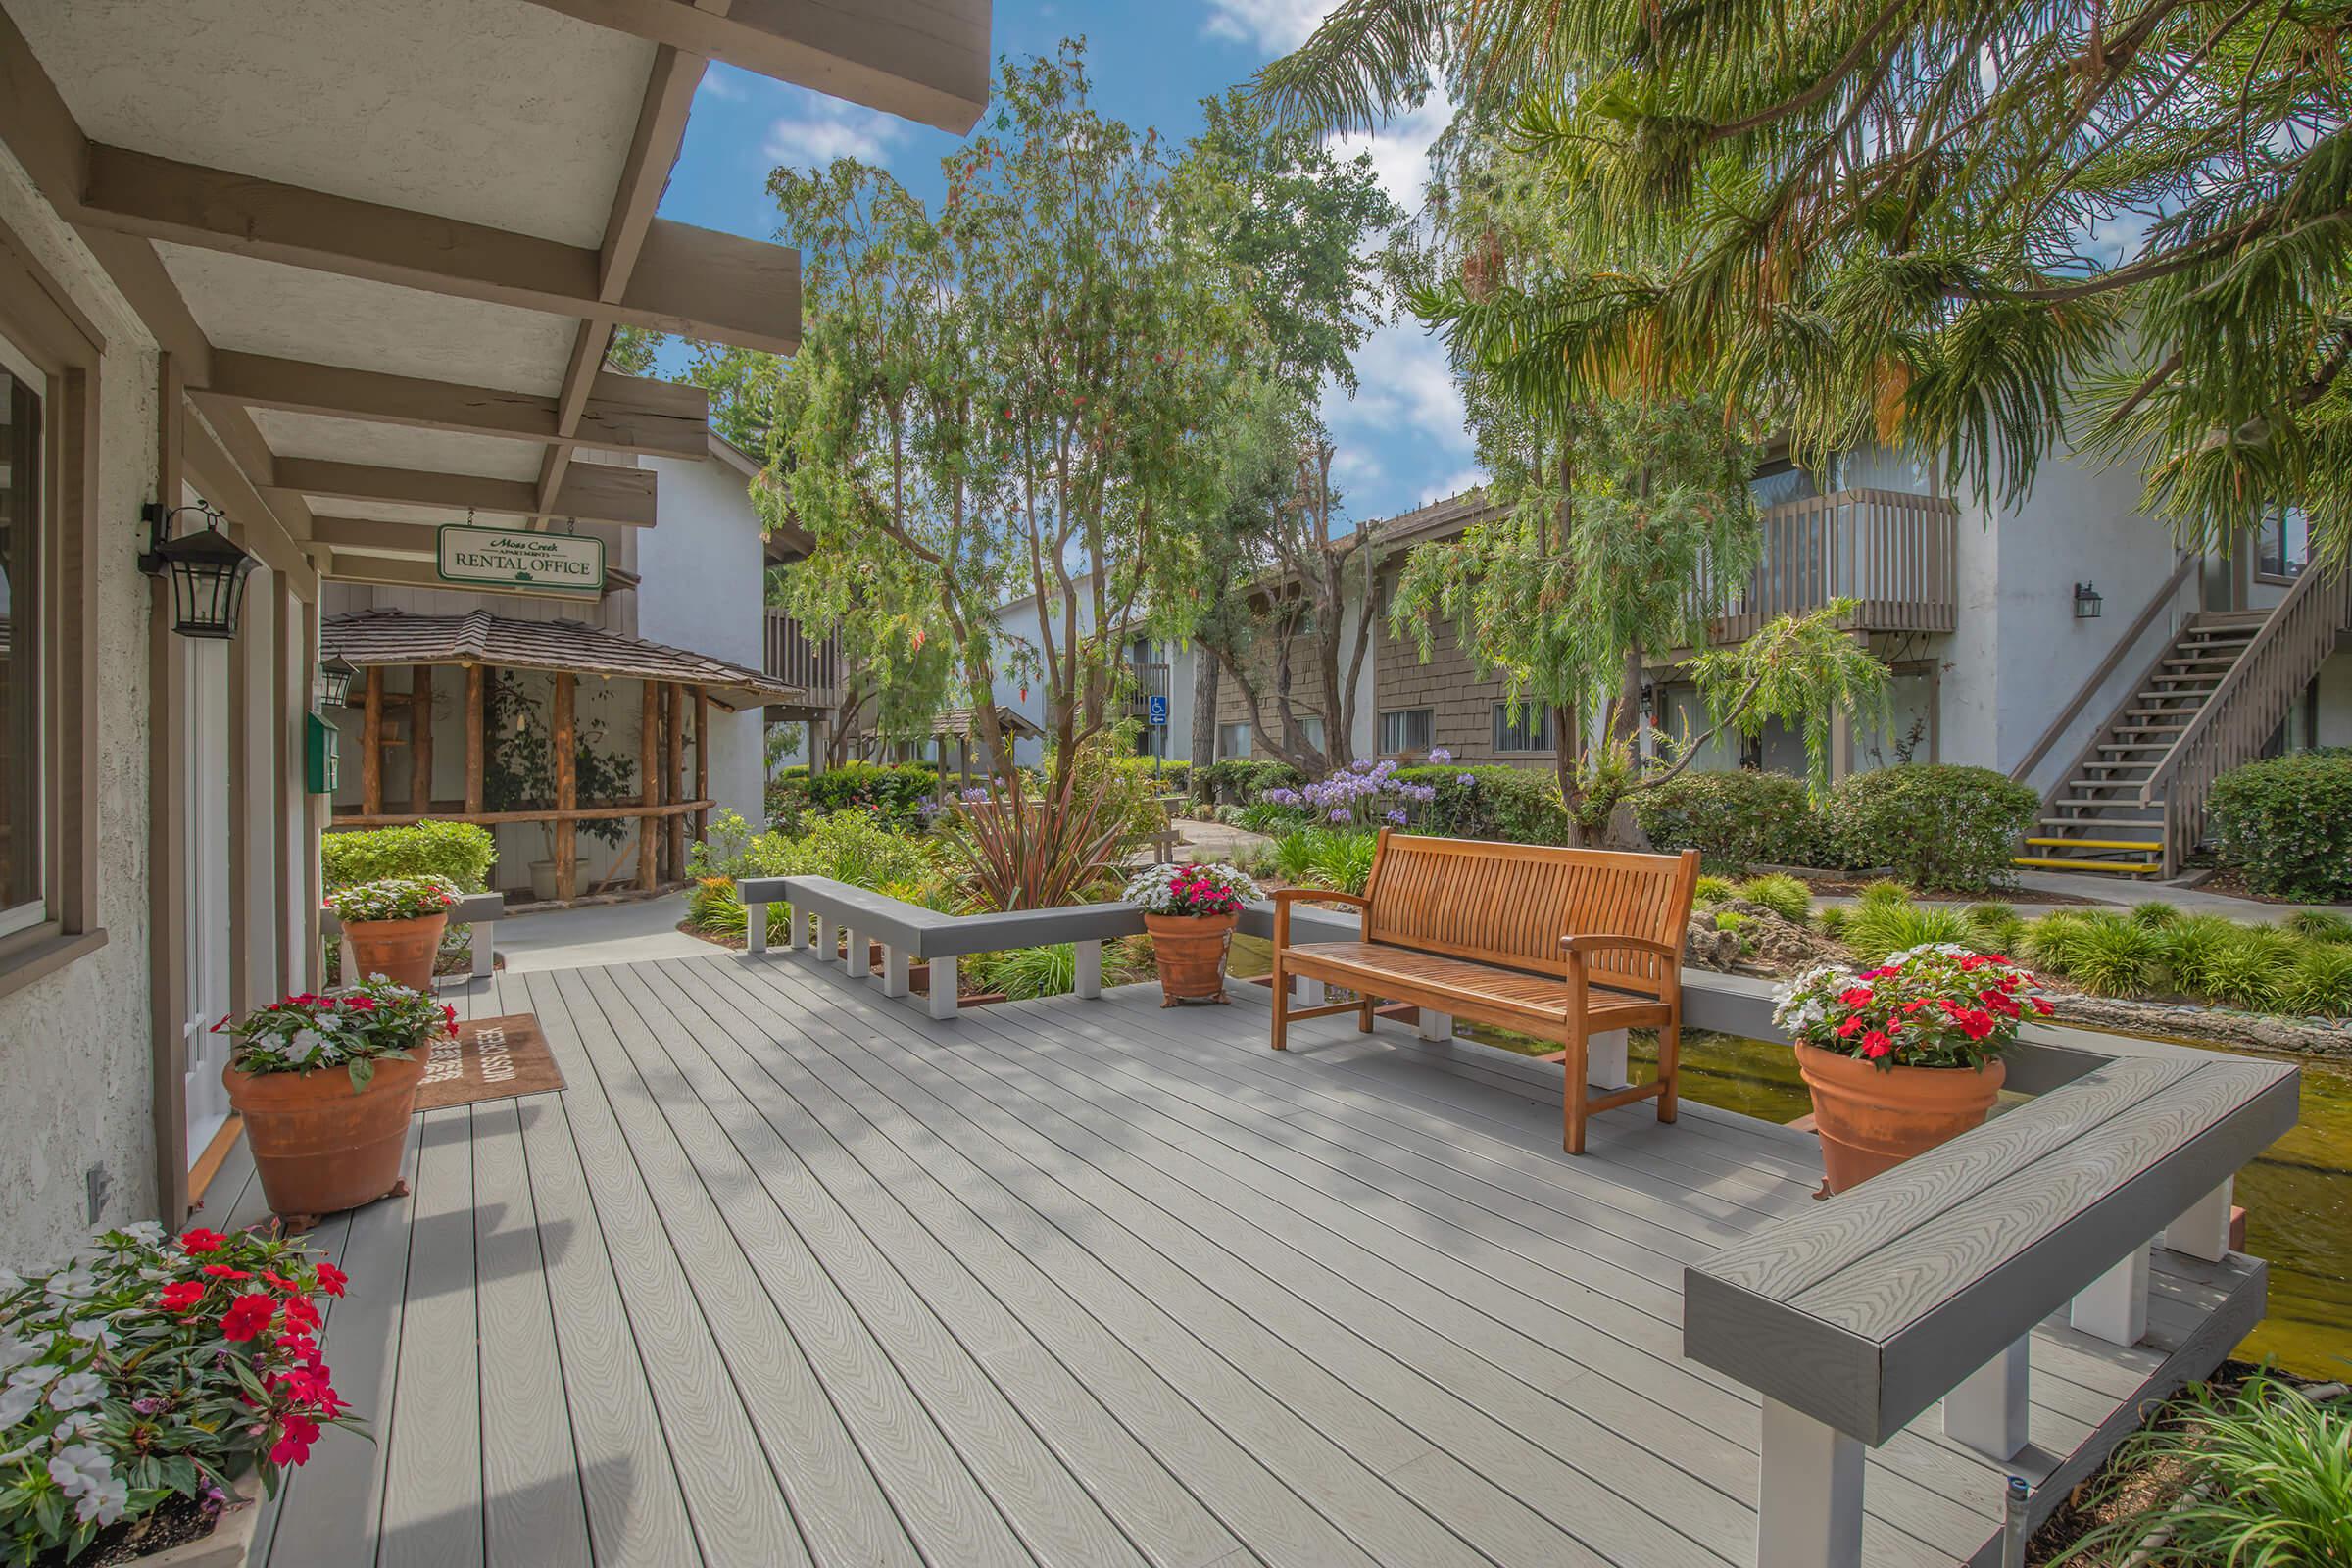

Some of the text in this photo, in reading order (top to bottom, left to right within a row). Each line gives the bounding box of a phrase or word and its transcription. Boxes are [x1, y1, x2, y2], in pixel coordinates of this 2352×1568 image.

[490, 538, 558, 552] Moss Creek
[499, 549, 550, 558] APARTMENTS
[455, 553, 590, 575] RENTAL OFFICE
[475, 1026, 517, 1083] MOSS CREEK
